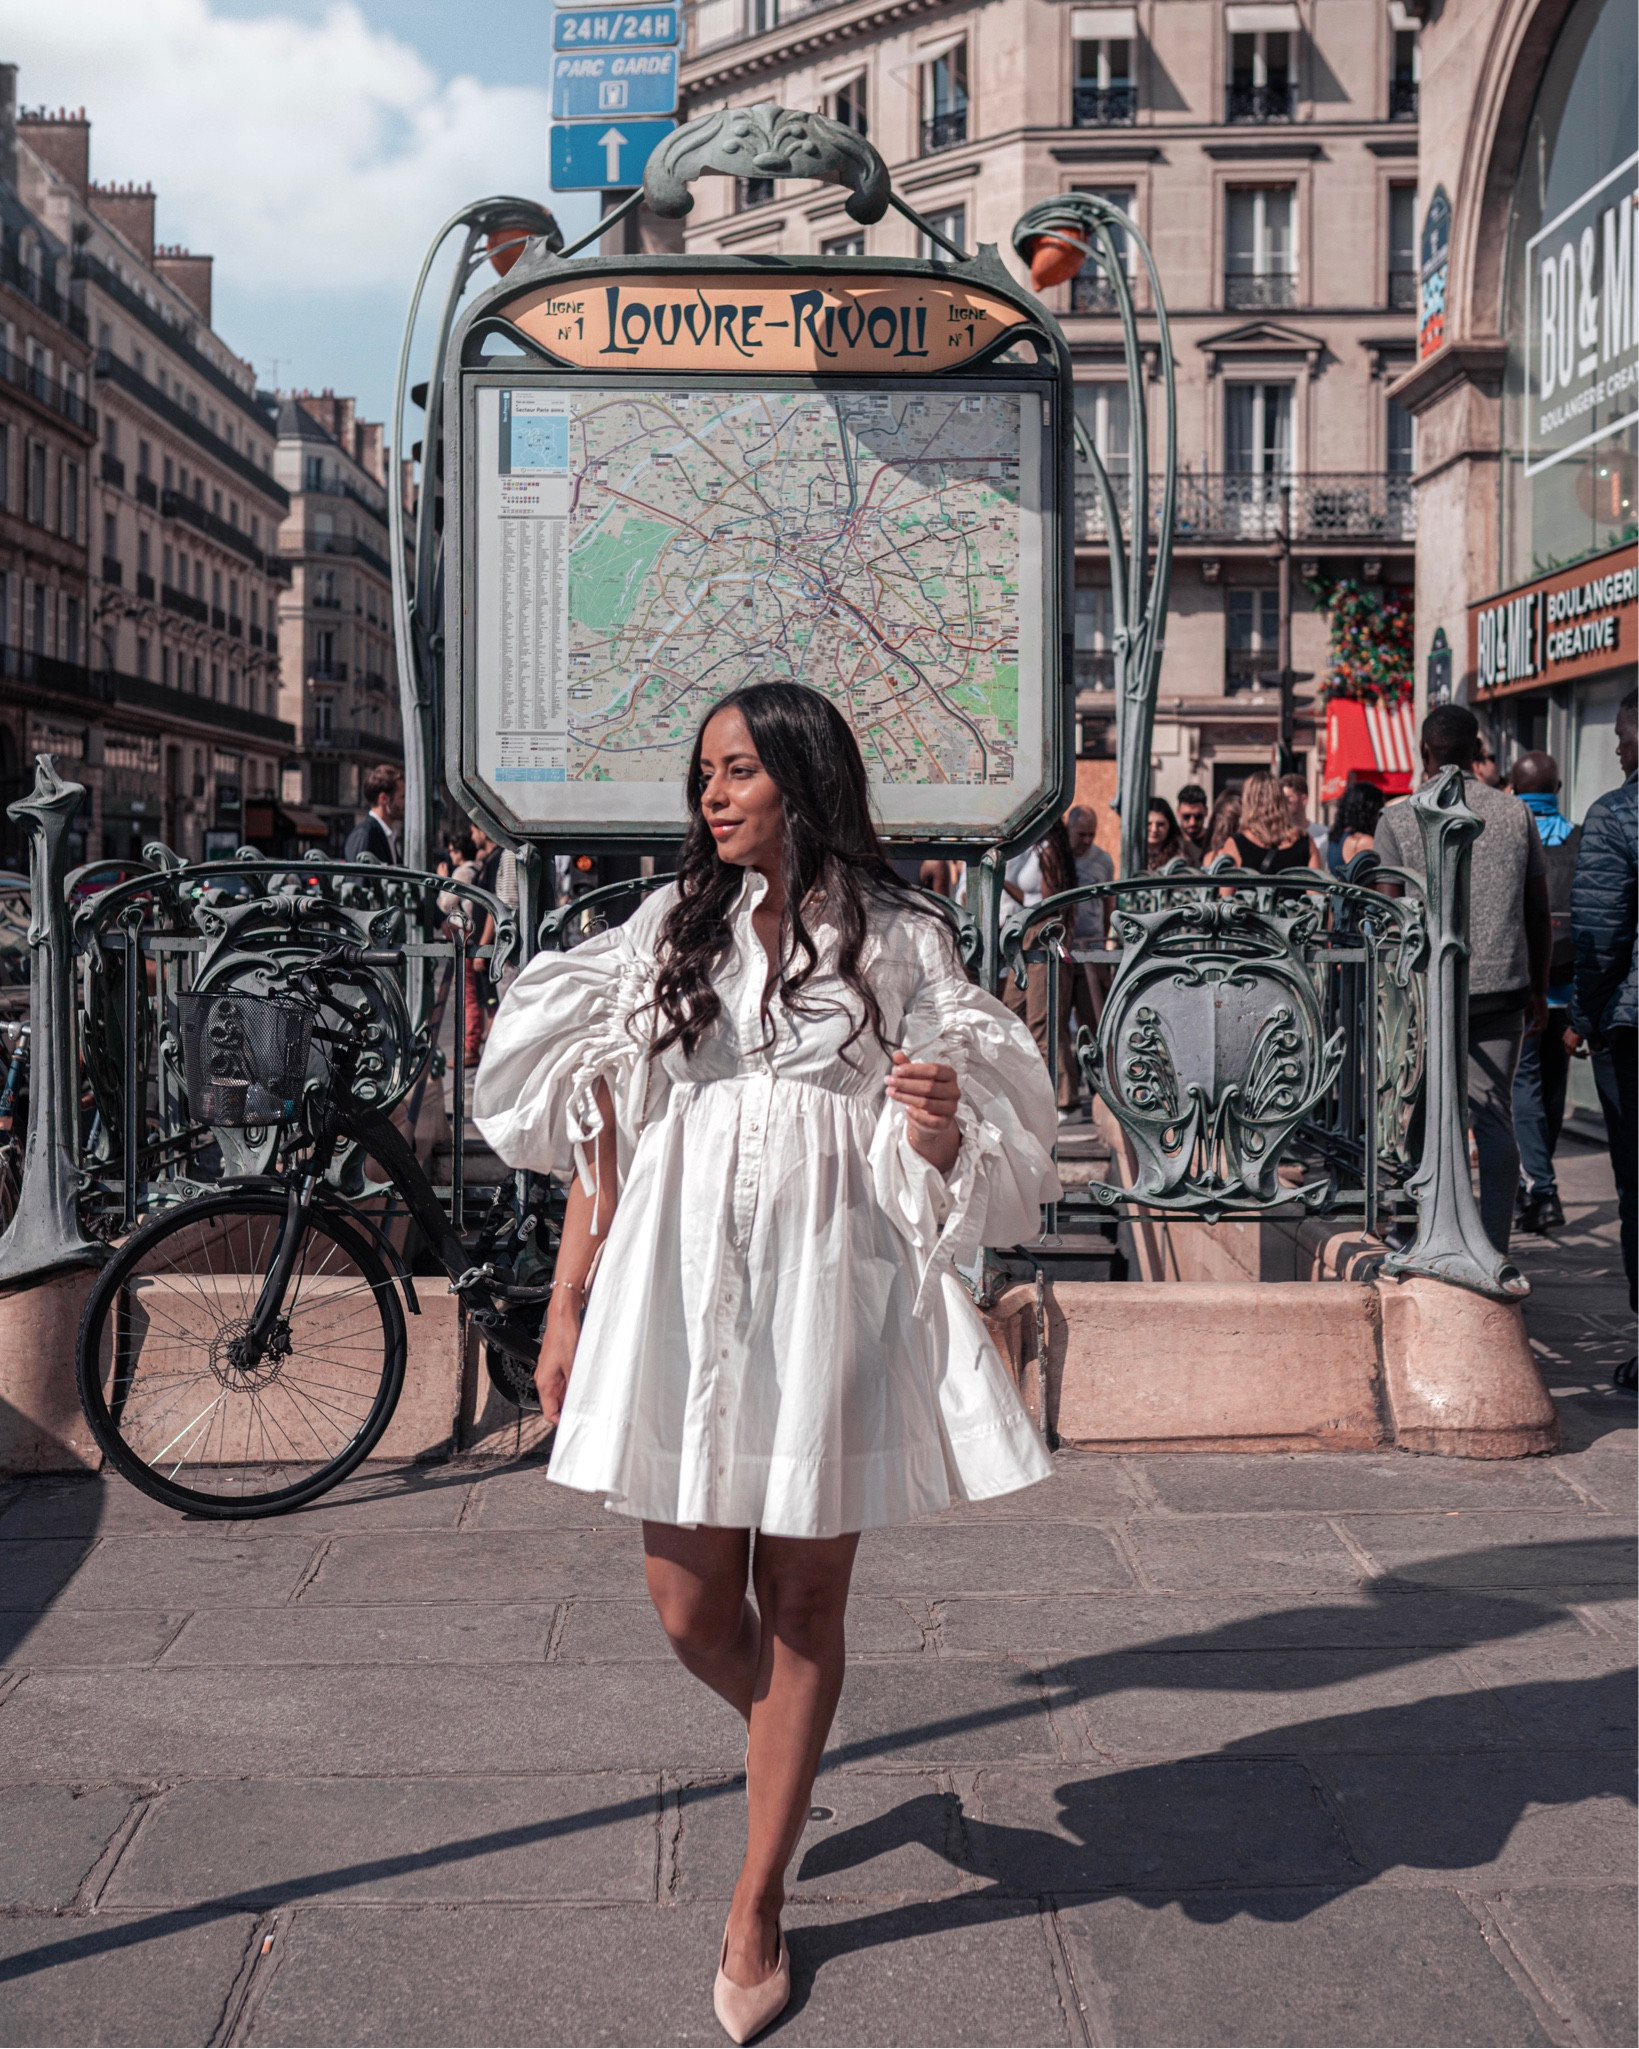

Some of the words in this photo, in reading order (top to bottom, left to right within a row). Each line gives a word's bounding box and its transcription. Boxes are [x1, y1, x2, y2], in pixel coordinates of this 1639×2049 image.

[562, 13, 670, 42] 24H/24H
[556, 58, 605, 79] PARC
[611, 53, 673, 76] GARDÉ
[574, 317, 584, 340] 1
[965, 324, 975, 347] 1
[1540, 380, 1605, 435] BOULANGERIE
[1477, 593, 1535, 689] BO&MIE
[1546, 616, 1615, 661] CREATIVE
